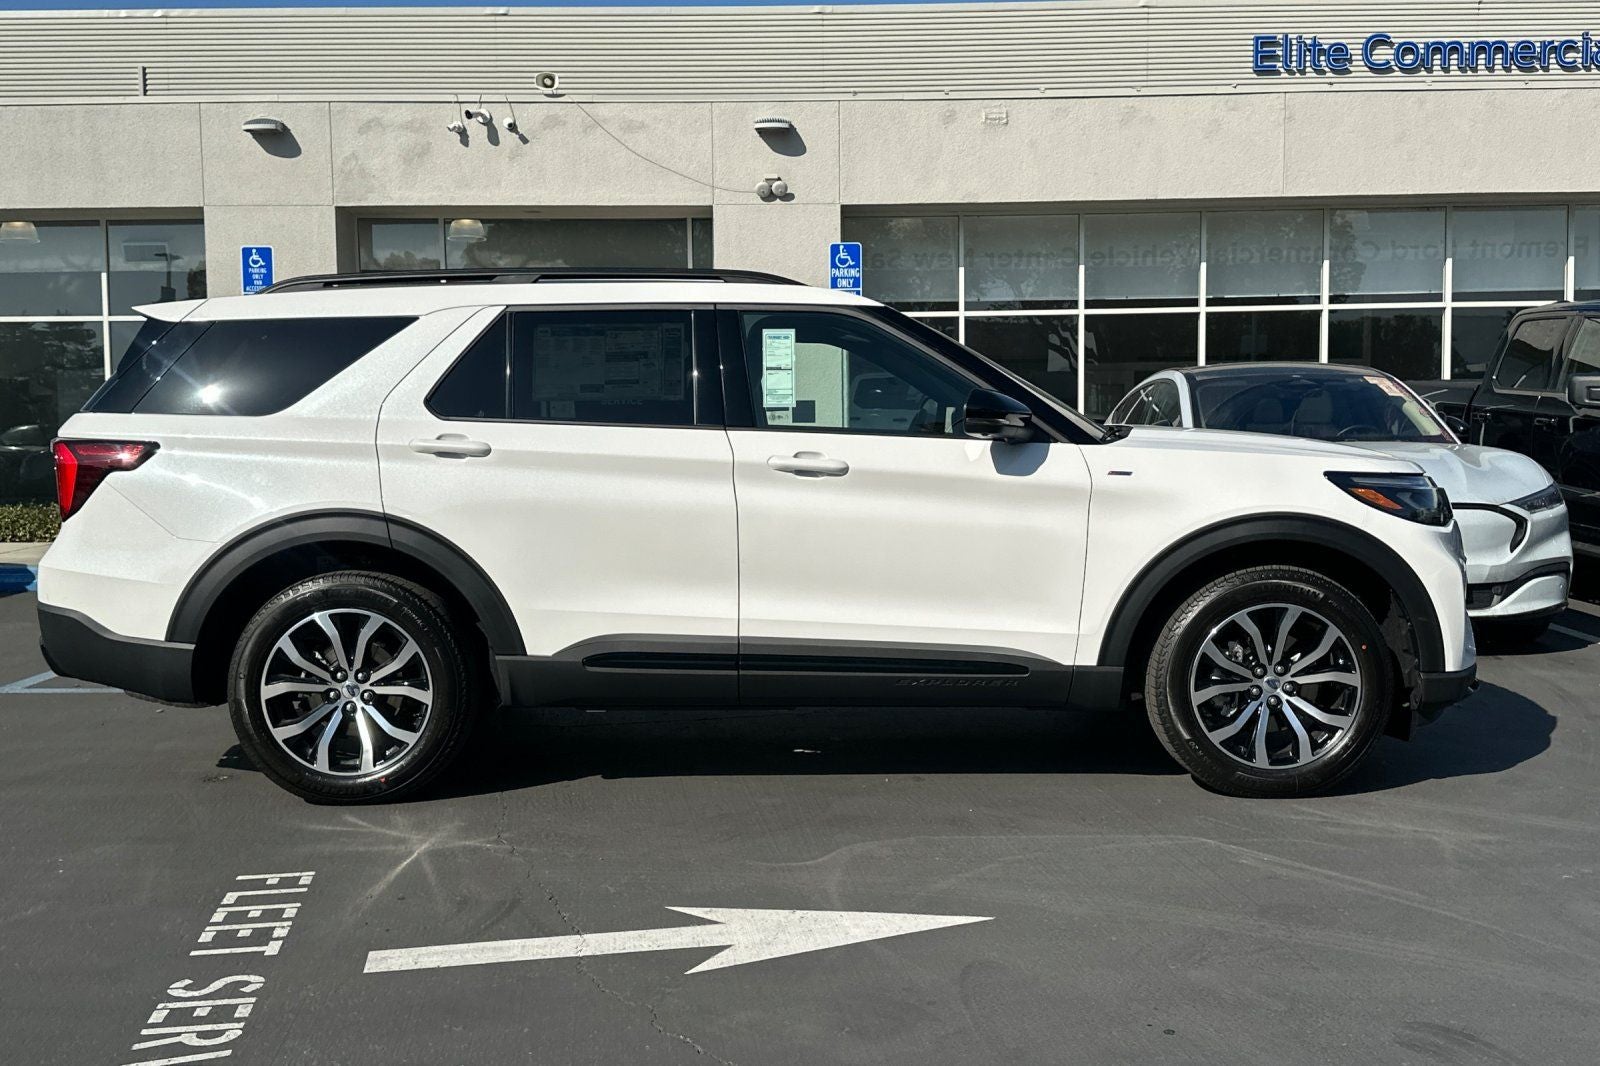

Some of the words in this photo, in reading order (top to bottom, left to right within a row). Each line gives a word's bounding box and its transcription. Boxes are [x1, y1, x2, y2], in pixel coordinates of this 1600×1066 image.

[1252, 32, 1351, 72] Elite
[1362, 31, 1600, 71] Commerci
[831, 268, 860, 278] PARKING
[837, 278, 854, 288] ONLY
[188, 871, 316, 957] FLEET
